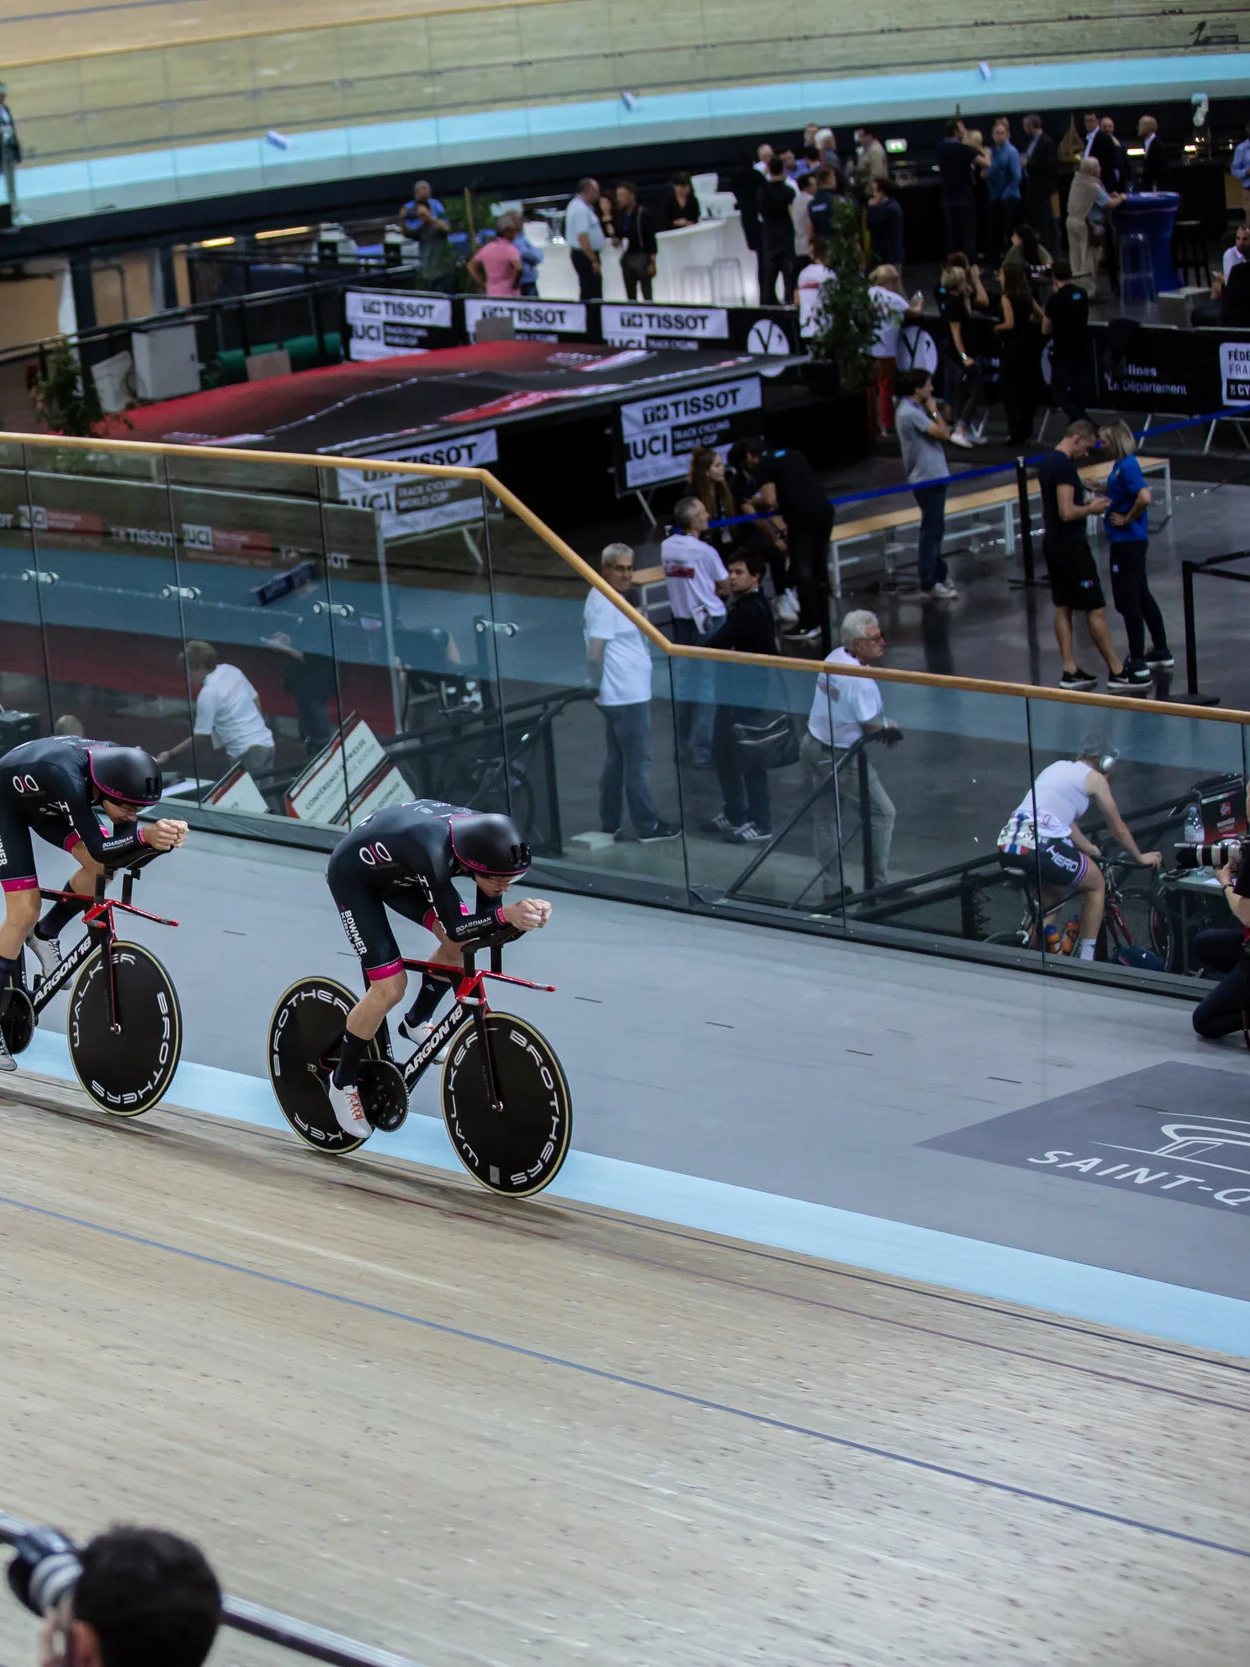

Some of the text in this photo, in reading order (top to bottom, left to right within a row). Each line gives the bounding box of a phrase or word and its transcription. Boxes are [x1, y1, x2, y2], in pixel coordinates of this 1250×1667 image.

[383, 301, 437, 319] TISSOT
[644, 313, 710, 331] TISSOT
[353, 324, 381, 341] UCI
[1229, 364, 1250, 376] FRA
[1122, 379, 1188, 396] Département
[670, 387, 741, 418] TISSOT
[632, 434, 668, 460] UCI
[127, 527, 176, 547] TISSOT
[185, 526, 211, 546] UCI
[102, 835, 134, 849] BOARDMAN
[1045, 844, 1079, 873] HERO
[344, 909, 368, 956] BOWMER
[455, 916, 492, 933] BOARDMAN
[35, 938, 93, 1005] ARGON 18
[272, 988, 350, 1077] BROTHER
[404, 1003, 465, 1081] ARGON 18
[91, 991, 170, 1105] BROTHERS
[509, 1028, 561, 1187] BROTHERS
